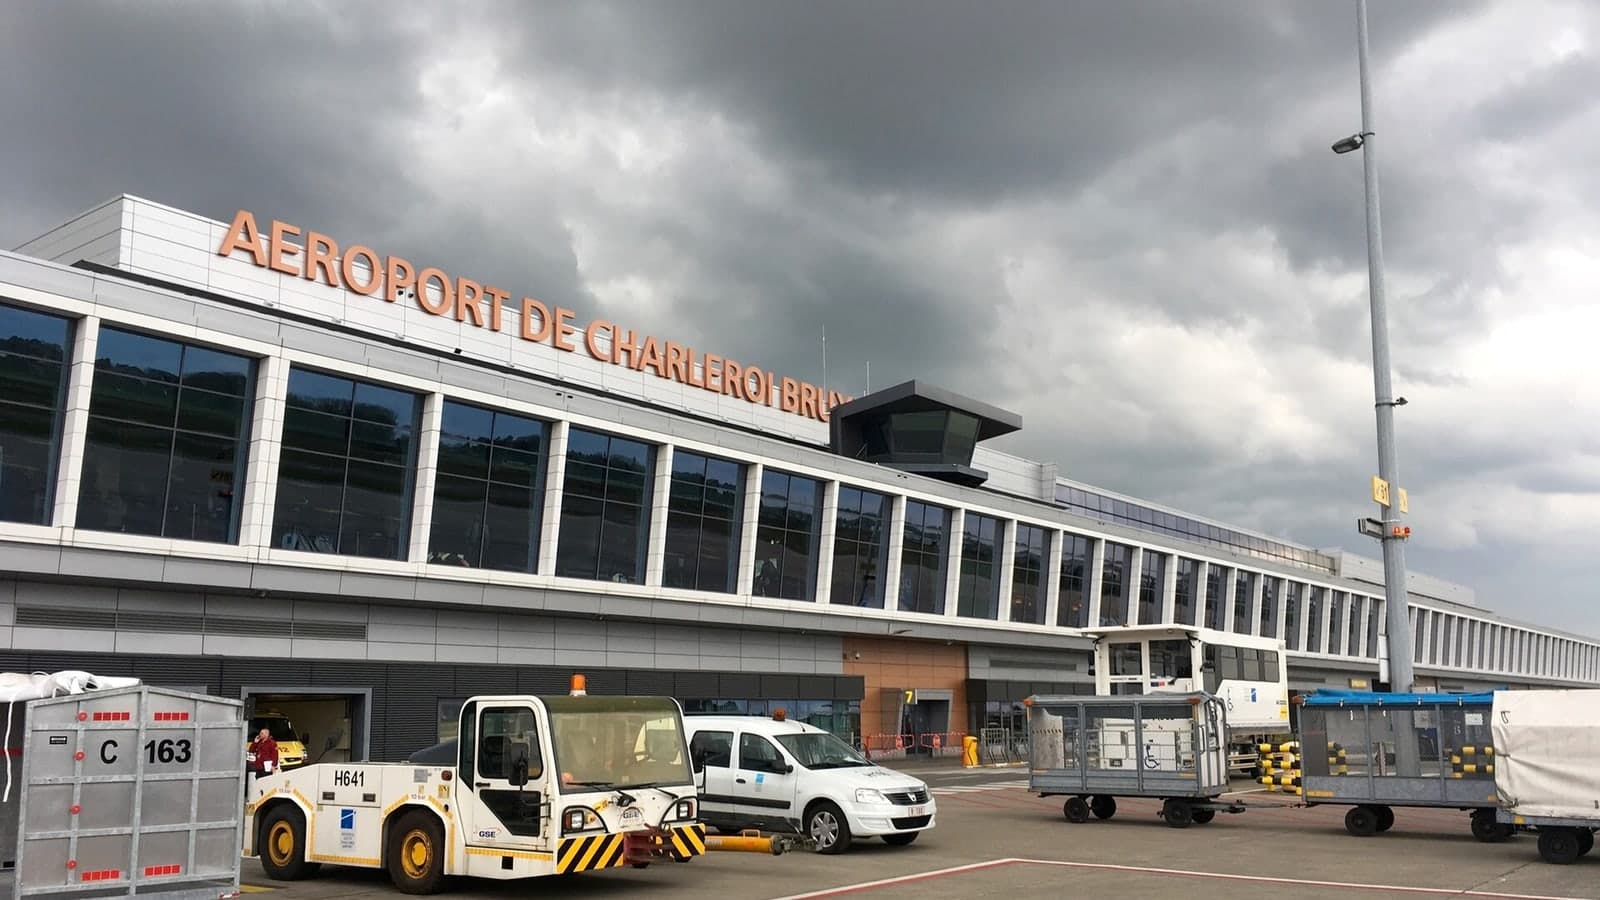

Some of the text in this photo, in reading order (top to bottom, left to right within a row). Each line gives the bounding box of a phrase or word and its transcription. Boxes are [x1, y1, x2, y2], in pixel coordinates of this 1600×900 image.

[218, 209, 510, 332] AEROPORT
[519, 297, 577, 352] DE
[585, 320, 774, 407] CHARLEROI
[905, 690, 913, 704] 7
[100, 738, 192, 765] C 163
[334, 770, 365, 787] H641
[478, 830, 497, 839] GSE
